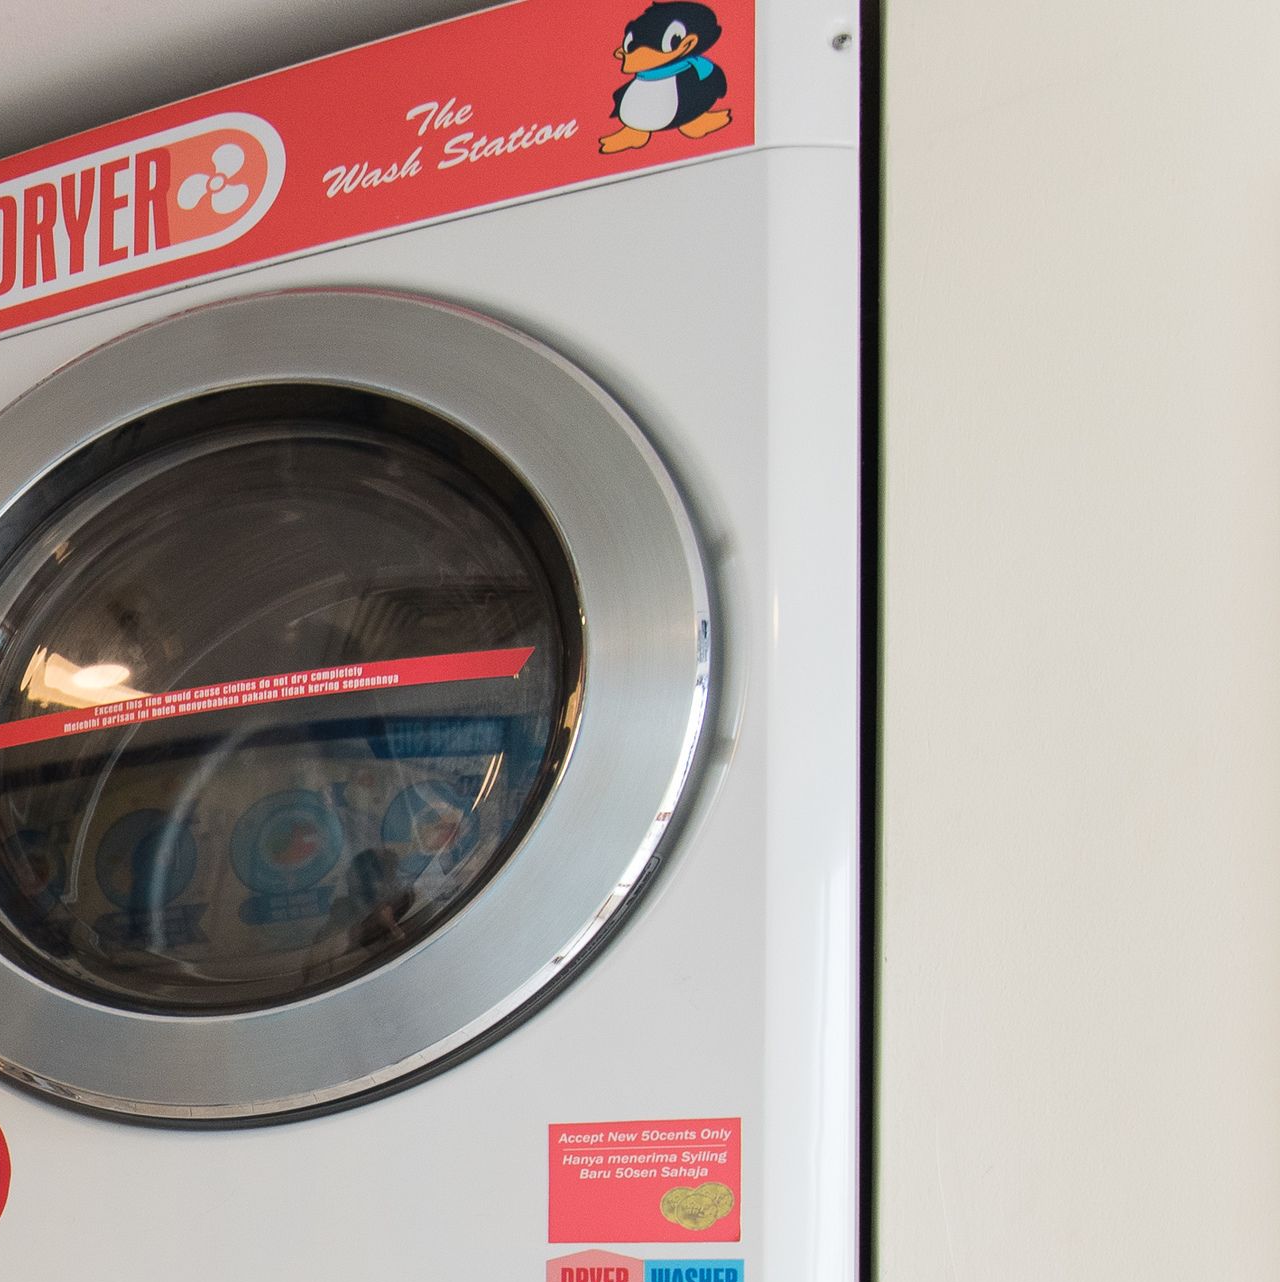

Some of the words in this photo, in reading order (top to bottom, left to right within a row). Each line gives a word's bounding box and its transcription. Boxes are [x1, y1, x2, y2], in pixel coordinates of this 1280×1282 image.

[407, 98, 473, 138] The
[324, 155, 422, 199] Wash
[437, 116, 579, 170] Station
[94, 704, 123, 716] Exceed
[126, 699, 142, 711] this
[145, 697, 162, 708] line
[164, 691, 191, 704] would
[194, 687, 220, 700] cause
[223, 682, 256, 696] clothes
[259, 678, 270, 689] do
[273, 675, 288, 687] not
[291, 673, 308, 685] dry
[310, 666, 363, 681] completely
[558, 1131, 604, 1145] Accept
[607, 1131, 637, 1142] New
[641, 1130, 697, 1141] 50cents
[700, 1128, 731, 1141] Only
[562, 1154, 604, 1166] Hanya
[607, 1152, 677, 1164] menerima
[681, 1151, 728, 1163] Syiling
[579, 1168, 611, 1179] Baru
[615, 1167, 657, 1178] 50sen
[661, 1166, 709, 1179] Sahaja
